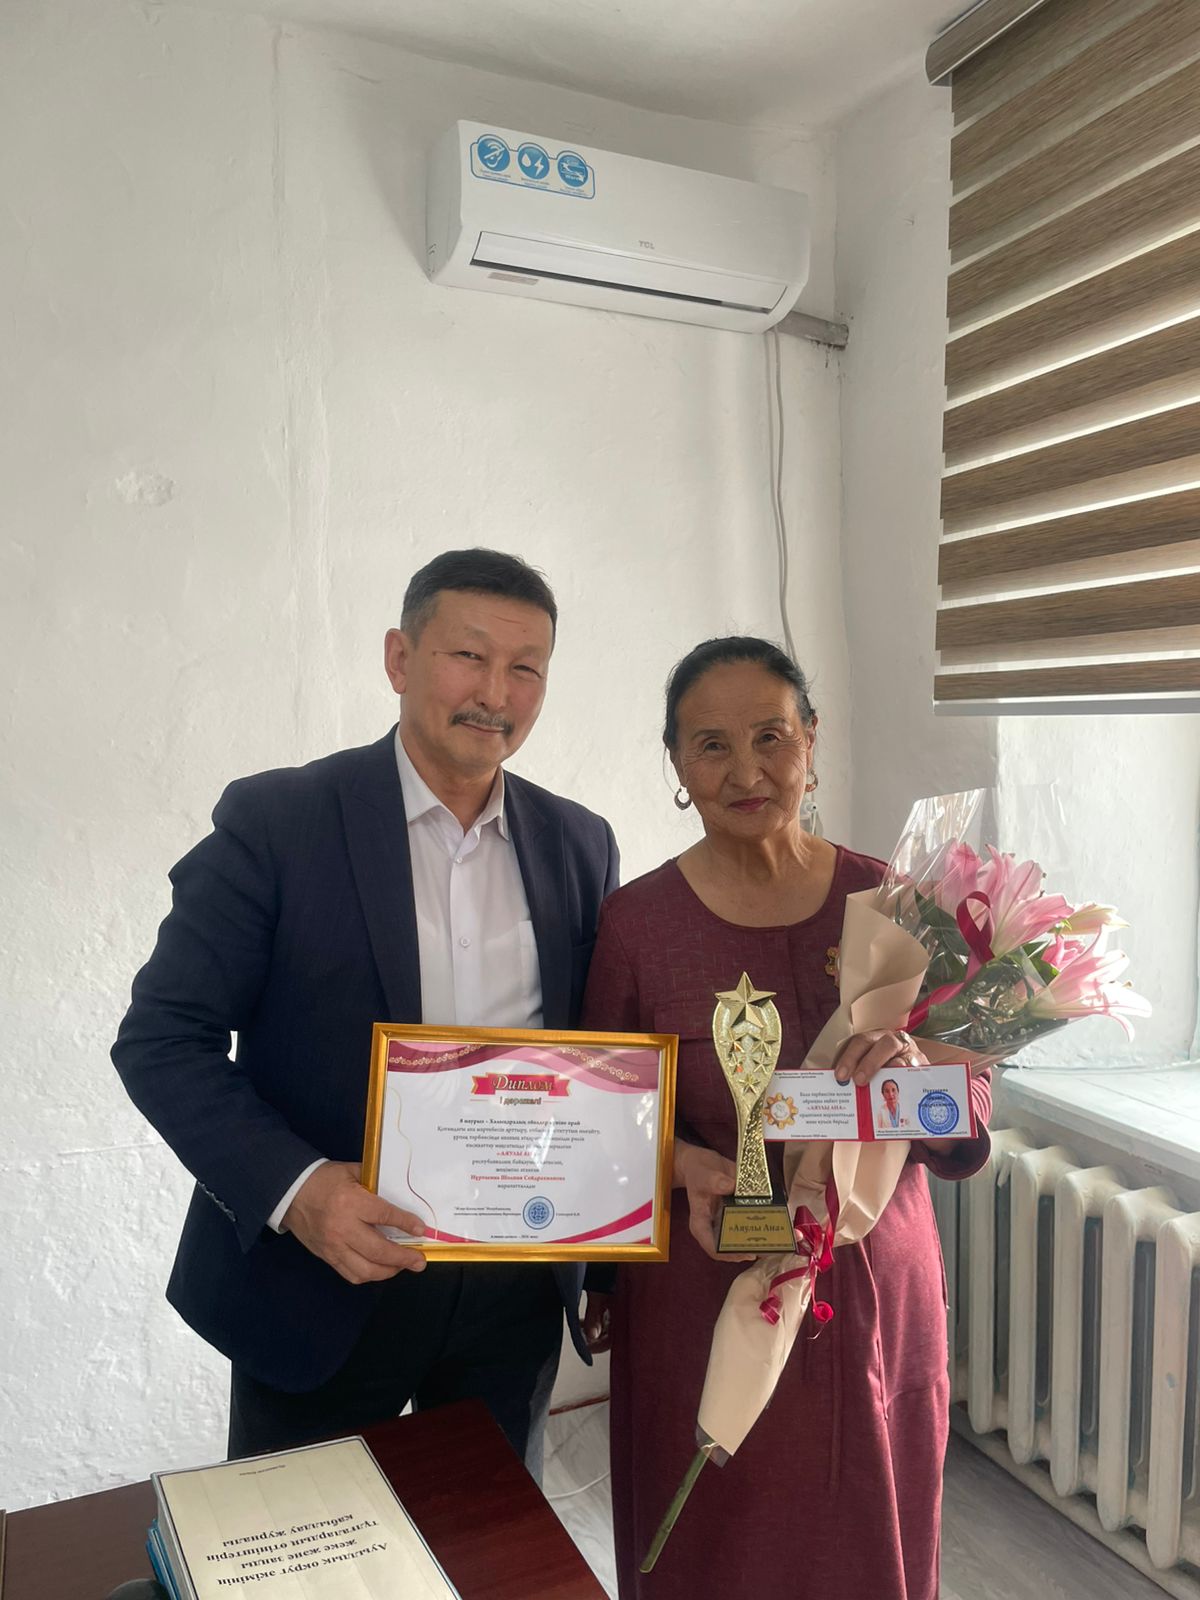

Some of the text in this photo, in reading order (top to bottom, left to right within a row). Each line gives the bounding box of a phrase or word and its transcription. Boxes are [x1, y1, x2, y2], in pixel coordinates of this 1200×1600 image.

[638, 240, 655, 250] TCL
[494, 1074, 553, 1090] Диплом
[729, 1223, 785, 1232] «Аяулы Ана»
[223, 1530, 287, 1547] журналы
[206, 1542, 288, 1562] өтініштерін
[241, 1539, 357, 1569] жеке және заңды
[280, 1561, 319, 1574] округ
[217, 1569, 276, 1586] әкімінің
